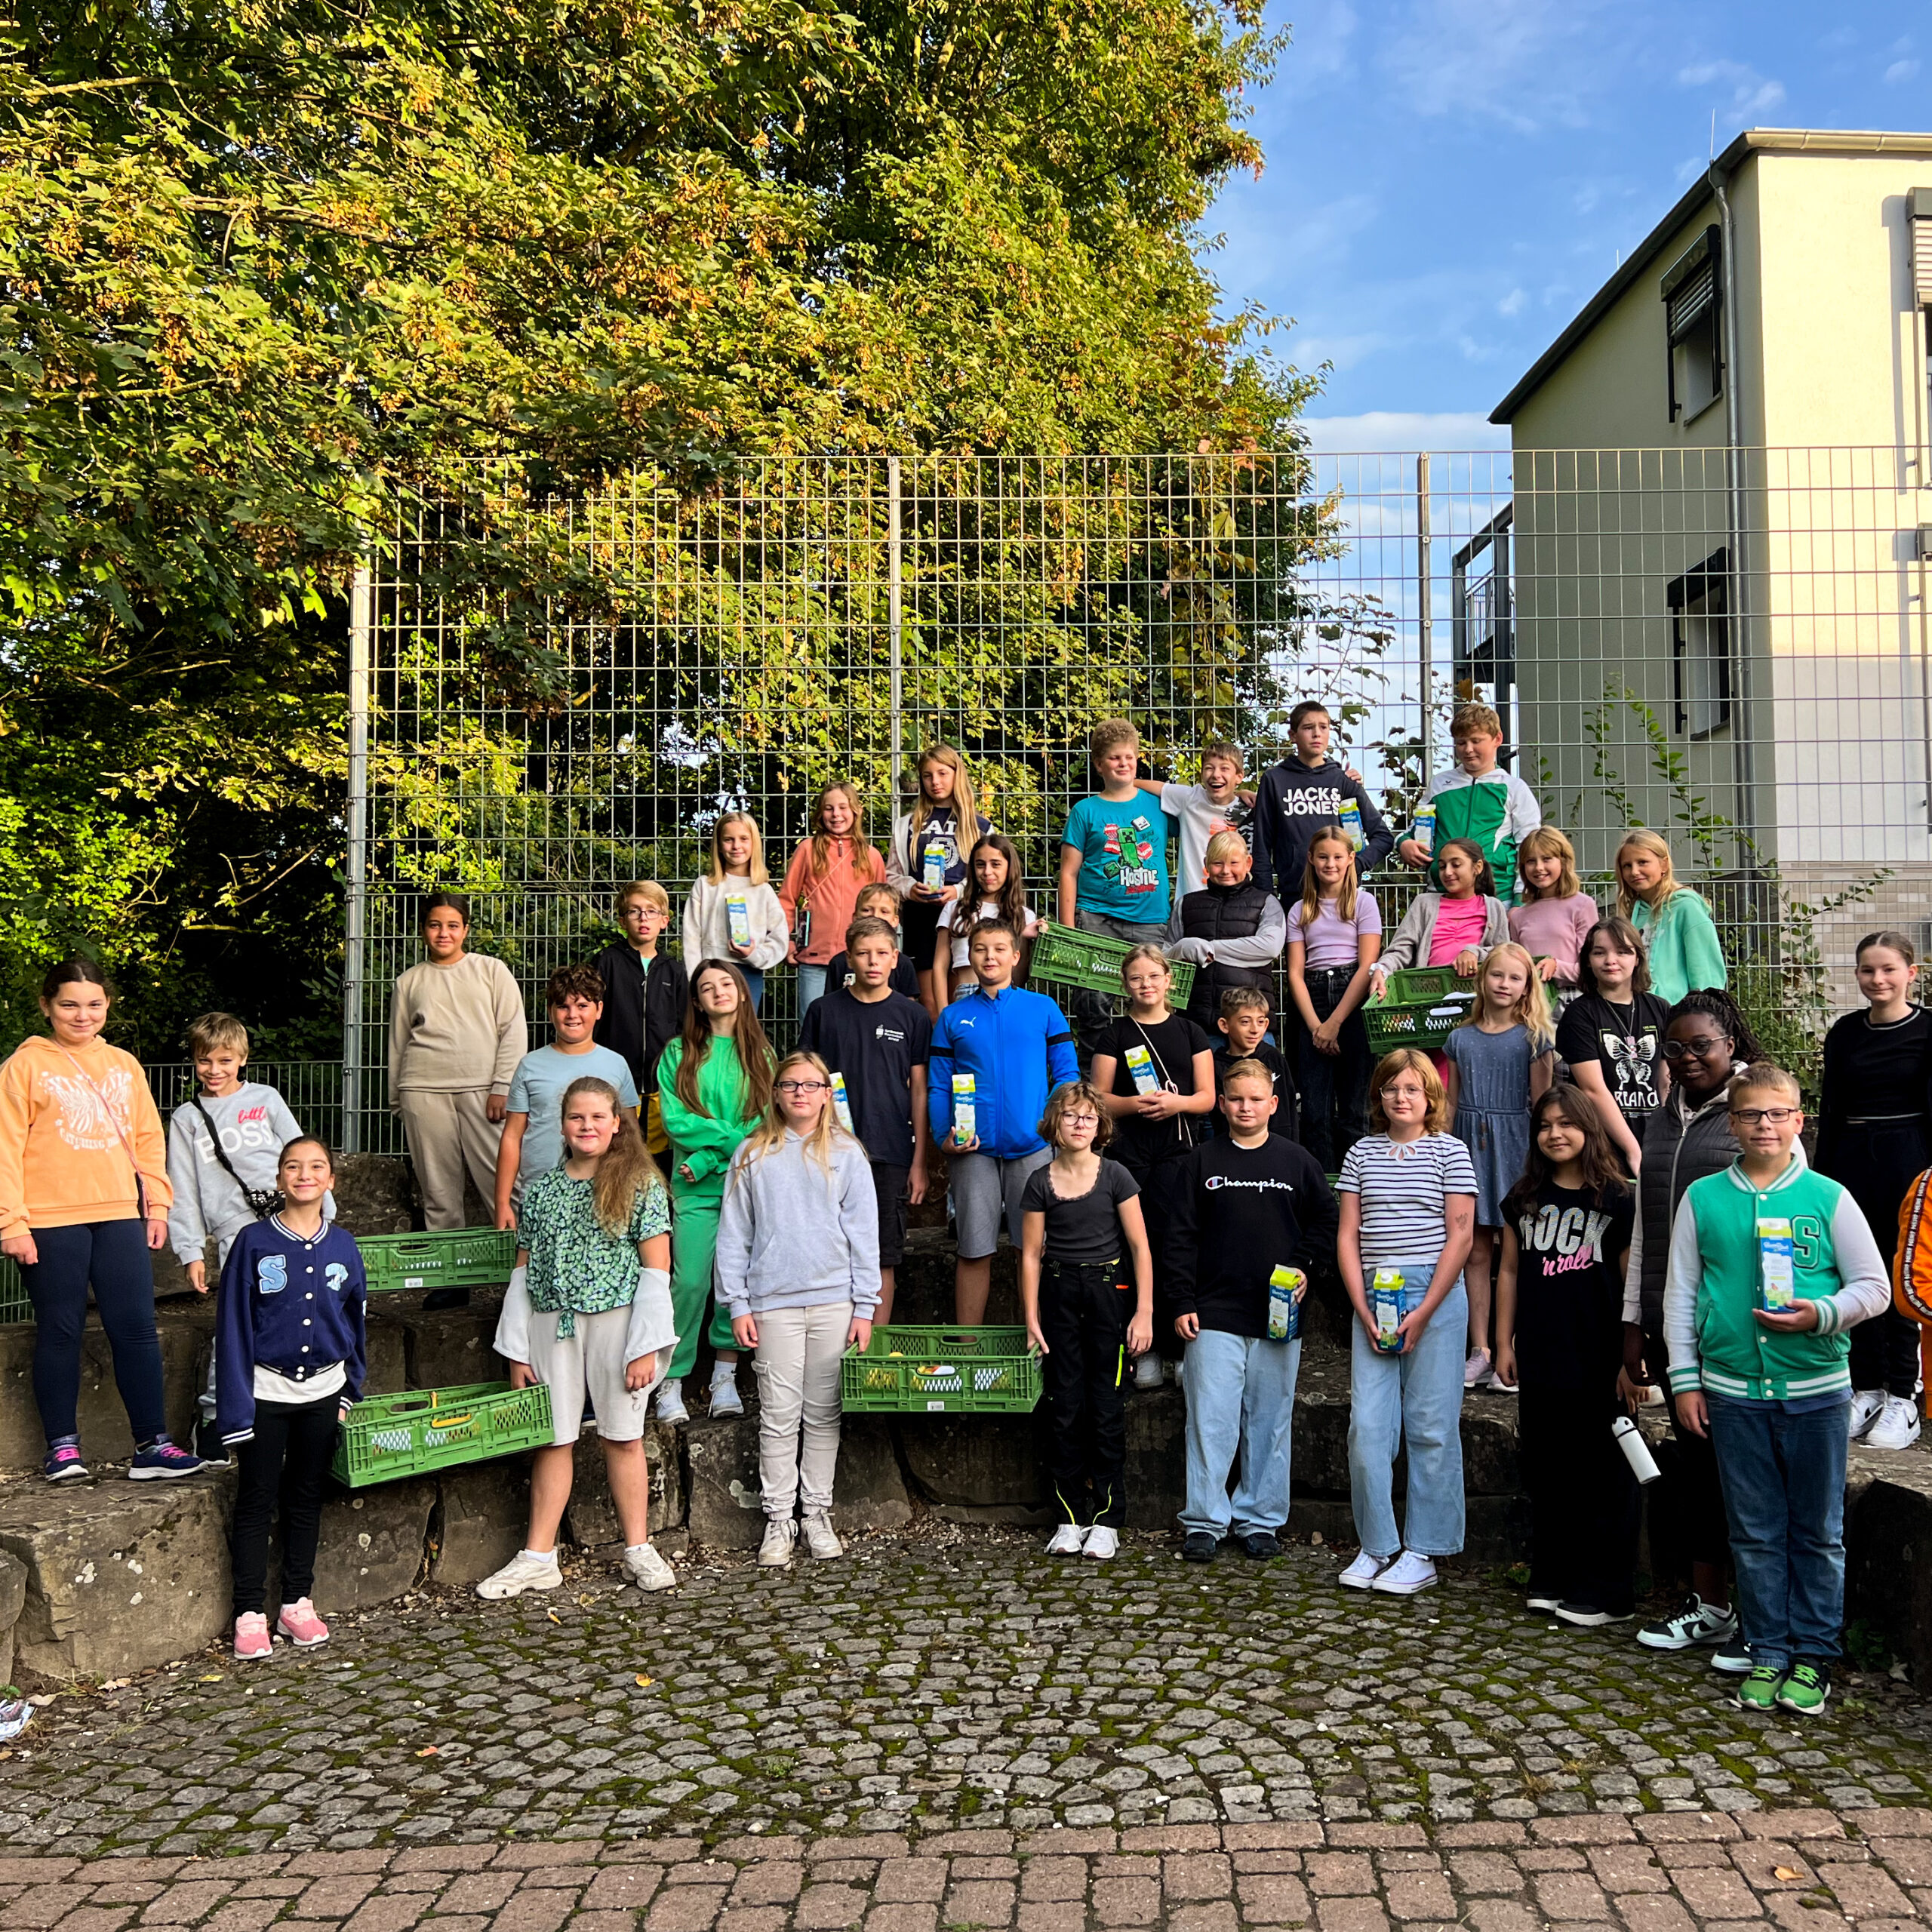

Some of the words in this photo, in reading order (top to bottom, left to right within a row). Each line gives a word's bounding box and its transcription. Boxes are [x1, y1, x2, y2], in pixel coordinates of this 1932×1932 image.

[1284, 801, 1340, 817] JONES
[1205, 1176, 1294, 1192] Champion
[1518, 1204, 1613, 1263] ROCK
[1791, 1215, 1820, 1269] S
[257, 1254, 288, 1294] S
